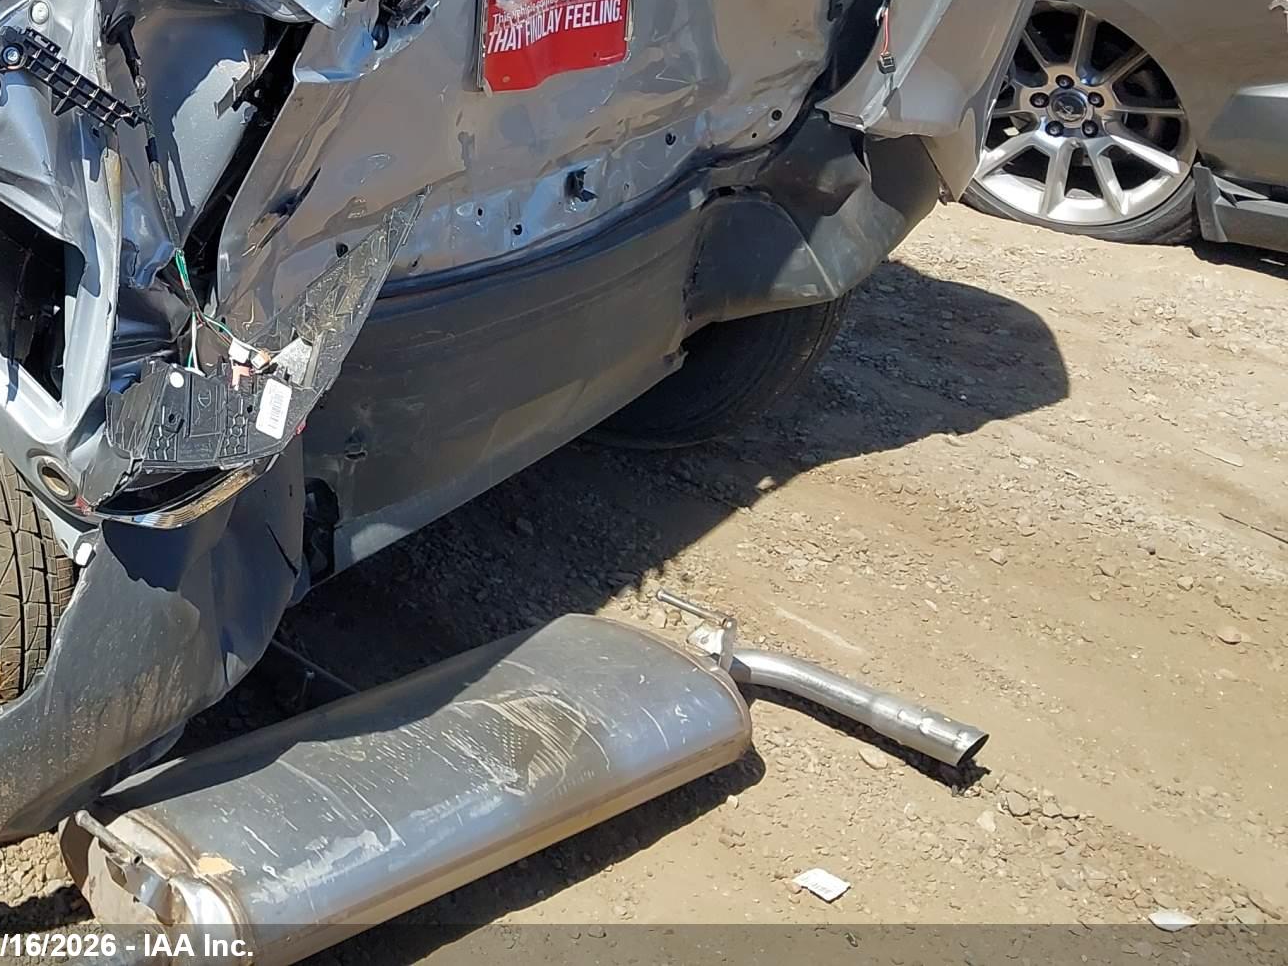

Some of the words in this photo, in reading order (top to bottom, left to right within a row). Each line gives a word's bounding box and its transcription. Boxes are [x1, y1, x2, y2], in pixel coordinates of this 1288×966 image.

[487, 24, 523, 54] THAT
[526, 7, 563, 46] FINDLAY
[493, 10, 512, 26] This
